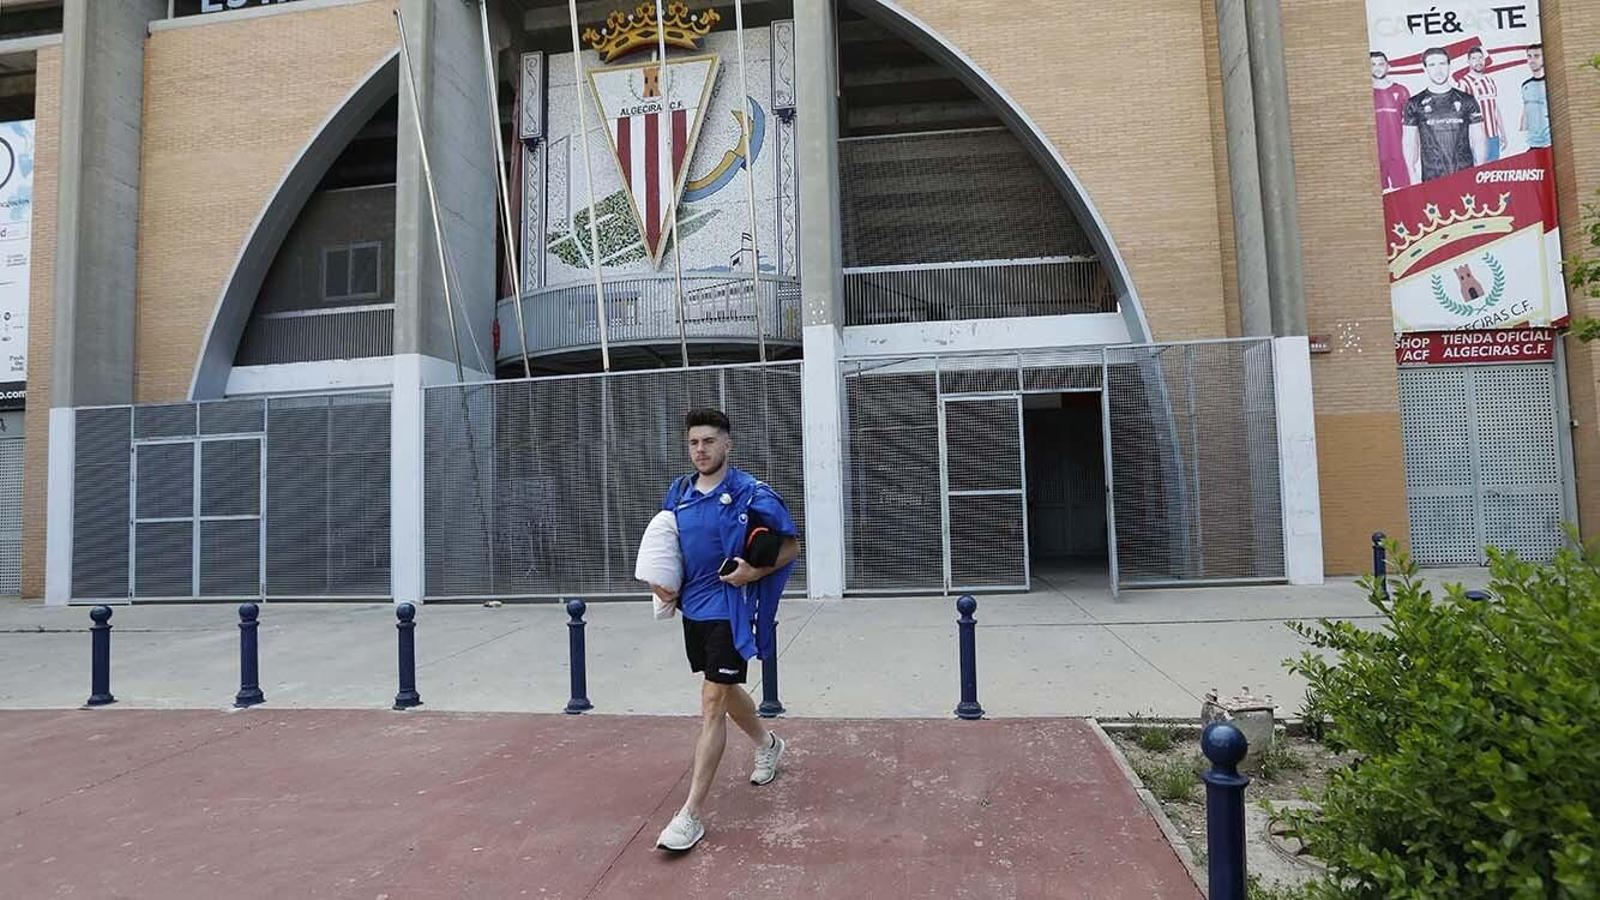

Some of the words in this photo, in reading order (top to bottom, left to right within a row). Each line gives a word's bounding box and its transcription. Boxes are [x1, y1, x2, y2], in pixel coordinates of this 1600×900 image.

[620, 103, 663, 116] ALGECIRA
[1475, 168, 1545, 184] OPERTRANSIT
[1511, 299, 1534, 317] C.F.
[1441, 332, 1494, 346] TIENDA
[1496, 329, 1552, 343] OFICIAL
[1443, 344, 1520, 358] ALGECIRAS
[1522, 343, 1548, 356] C.F.
